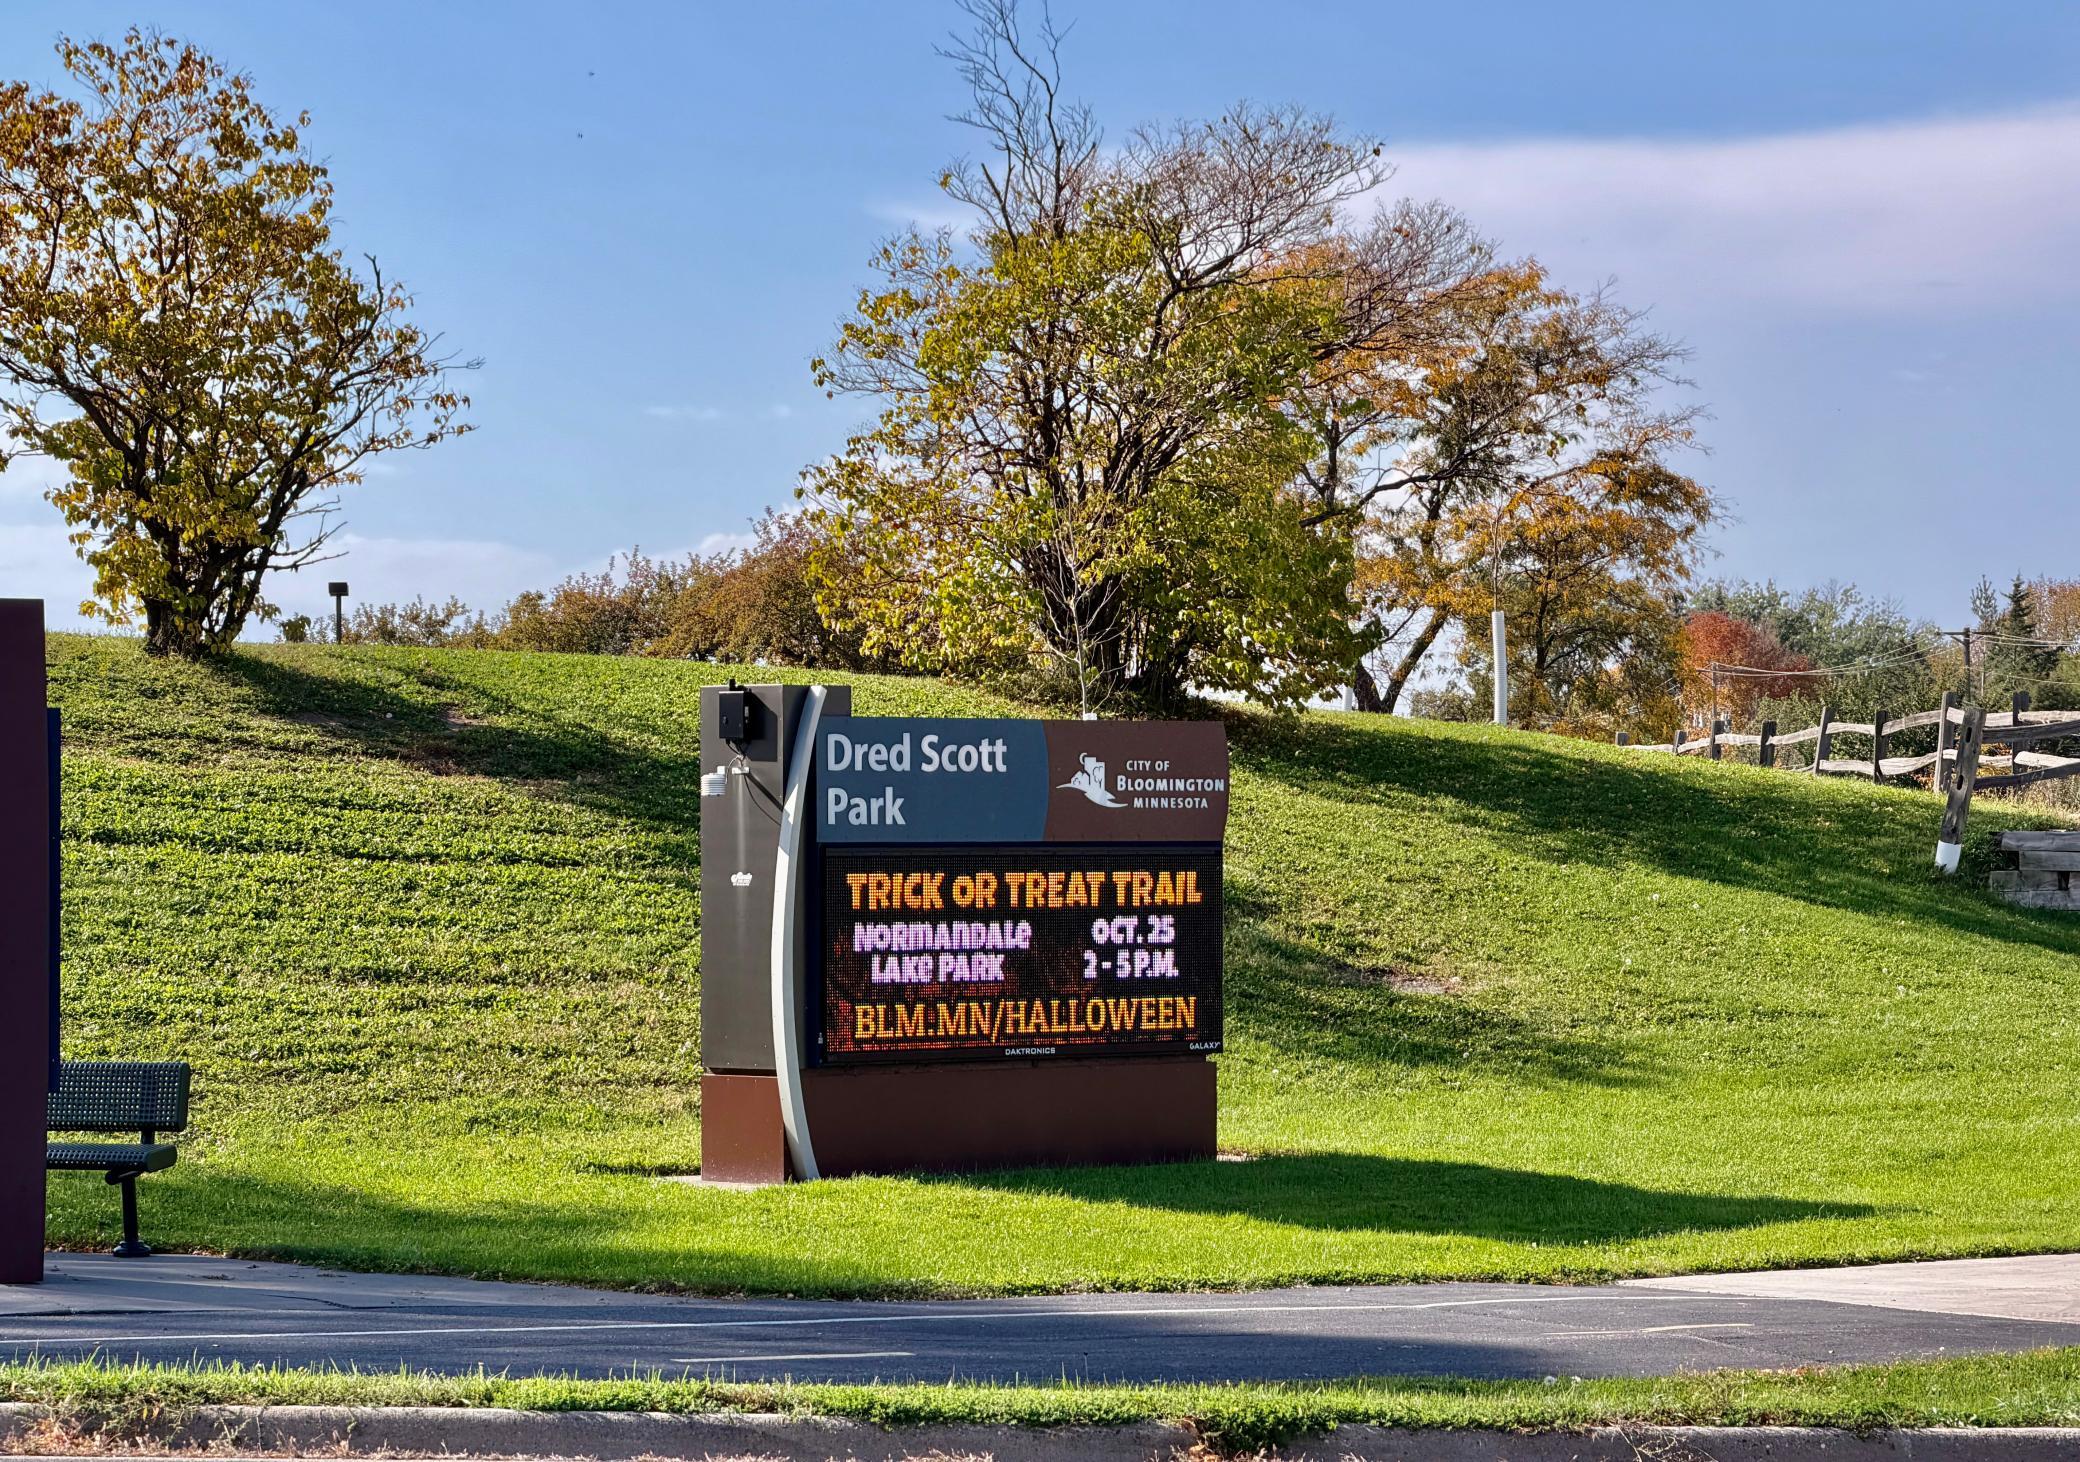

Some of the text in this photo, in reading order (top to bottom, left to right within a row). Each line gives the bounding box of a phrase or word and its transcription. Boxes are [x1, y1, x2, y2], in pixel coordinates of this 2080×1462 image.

[827, 732, 1007, 773] Dred Scott
[1126, 760, 1170, 771] CITY OF
[1117, 775, 1225, 792] BLOOMINGTON
[827, 786, 906, 826] Park
[1133, 797, 1208, 809] MINNESOTA
[846, 870, 1202, 911] TRICK OR TREAT TRAIL
[853, 920, 1032, 953] NORMANDALE
[1091, 915, 1176, 945] OCT. 25
[871, 952, 1005, 984] LAKE PARK
[1083, 950, 1098, 979] 2
[1101, 961, 1112, 970] -
[855, 996, 1197, 1043] BLM.MN/HALLOWEEN
[1005, 1048, 1056, 1056] DAKTRONICS
[1189, 1042, 1220, 1050] GALAXY
